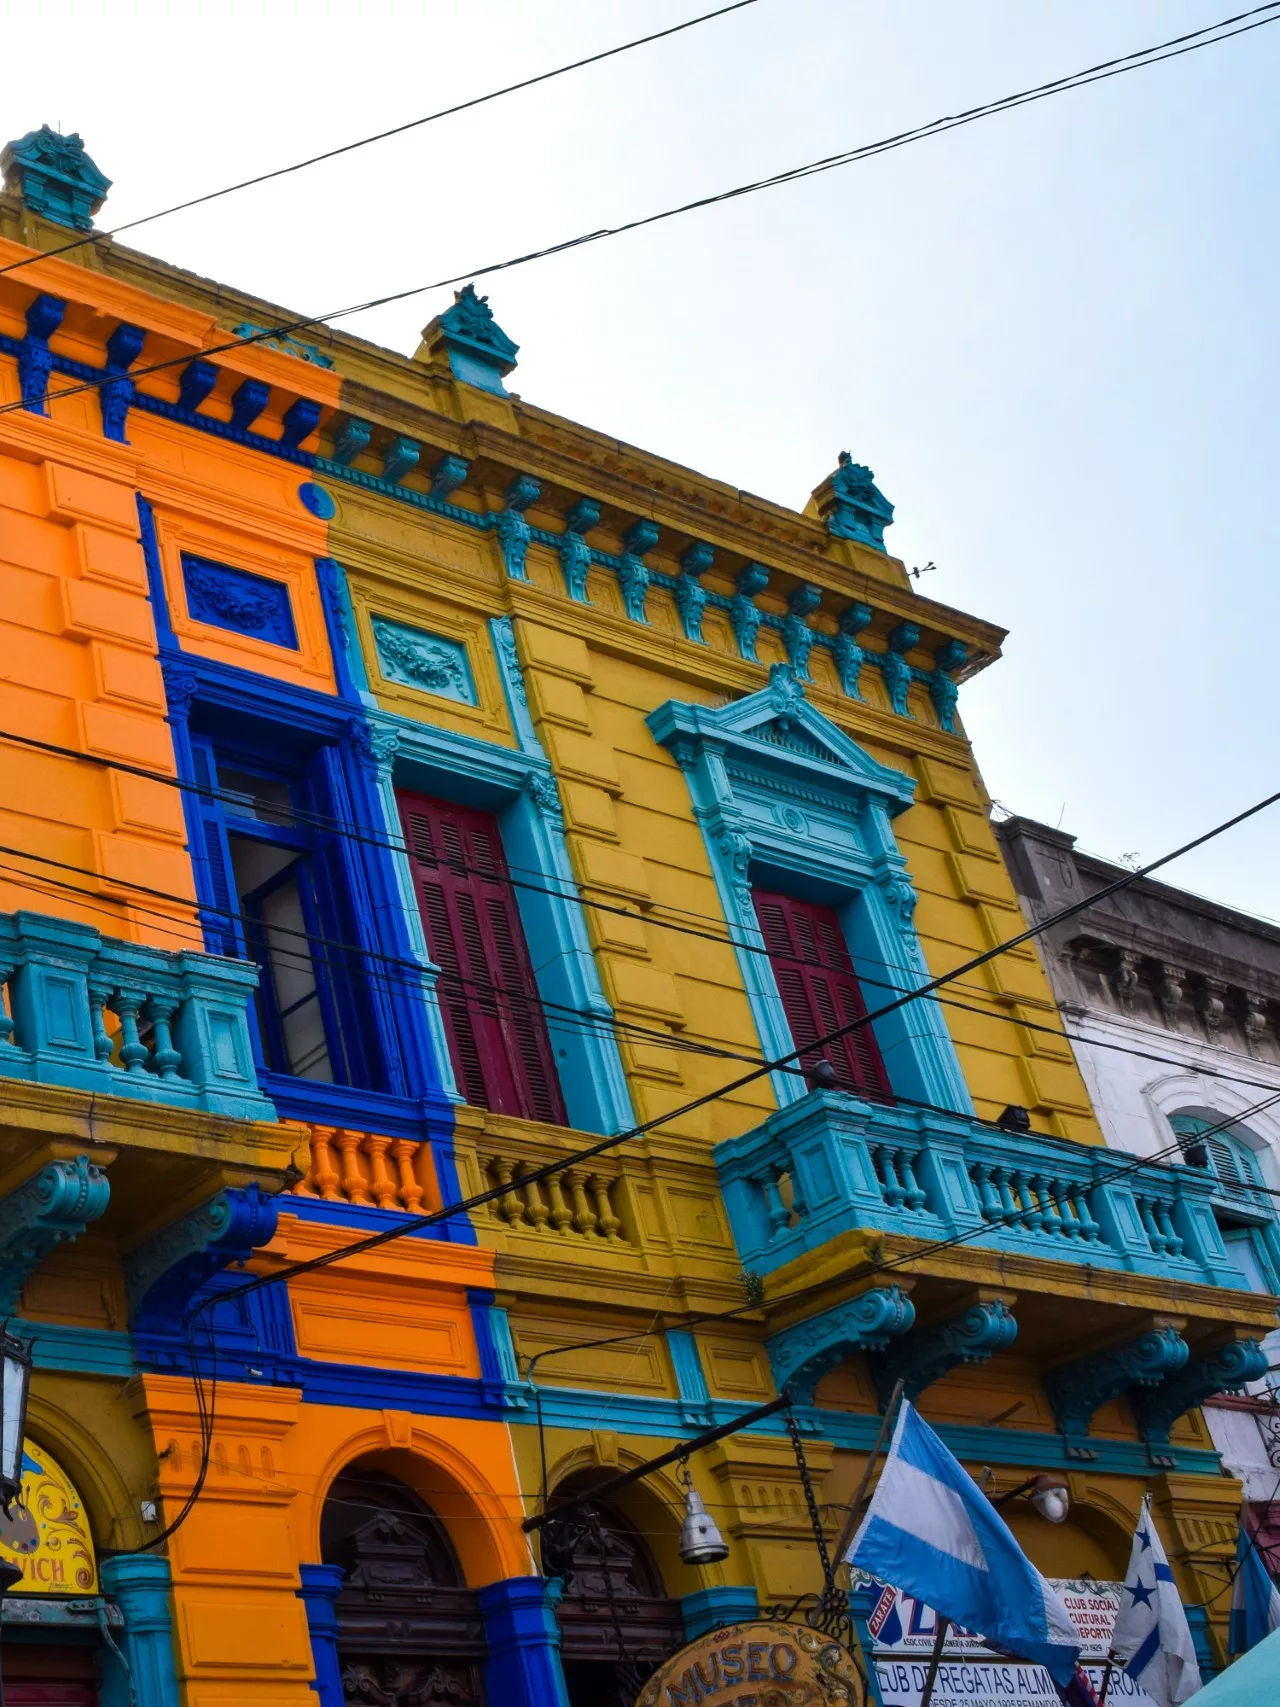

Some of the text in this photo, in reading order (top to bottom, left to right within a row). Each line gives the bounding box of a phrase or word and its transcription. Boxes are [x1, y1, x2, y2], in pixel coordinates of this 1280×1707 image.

[871, 1589, 895, 1632] ZARATE
[1064, 1597, 1118, 1611] CLUB SOCIAL
[1069, 1612, 1112, 1626] CULTURAL
[1089, 1643, 1103, 1652] 1929
[665, 1640, 799, 1706] MUSEO
[877, 1664, 910, 1693] LUB
[939, 1666, 1014, 1694] REGATAS
